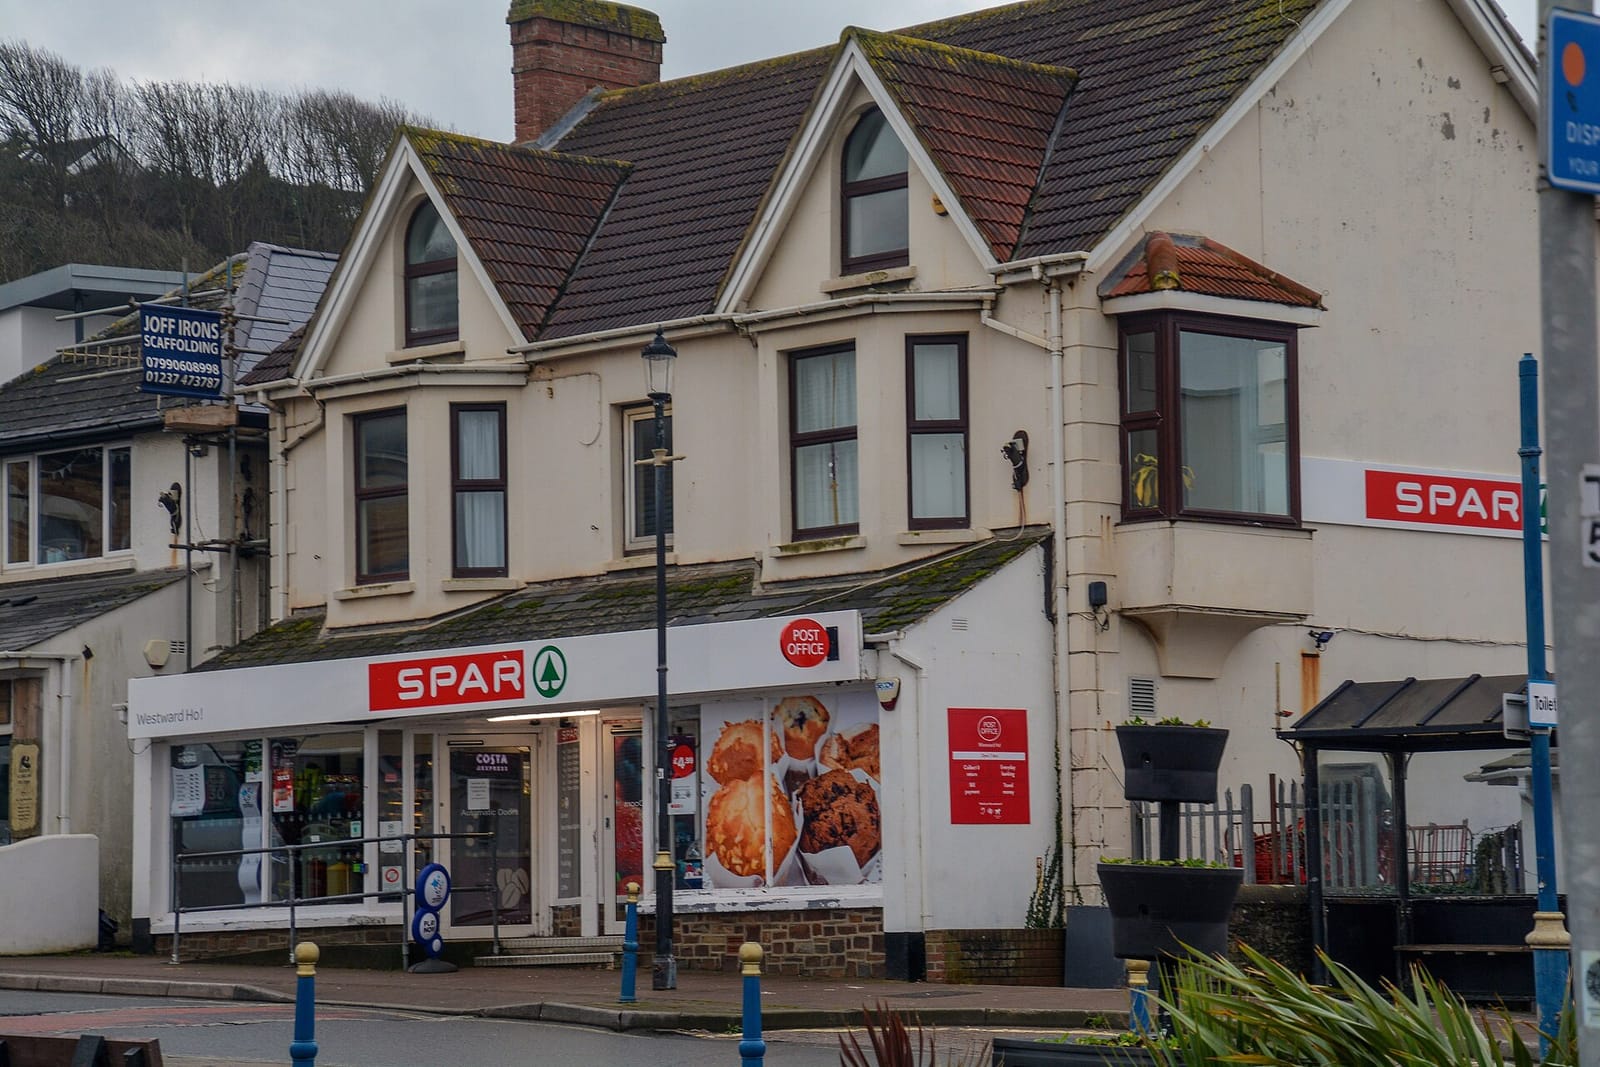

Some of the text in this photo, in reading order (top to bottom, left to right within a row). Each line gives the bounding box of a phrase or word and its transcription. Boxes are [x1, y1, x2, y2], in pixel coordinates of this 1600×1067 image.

[143, 315, 219, 340] JOFF IRONS
[143, 334, 219, 355] SCAFFOLDING
[145, 356, 220, 375] 07990608998
[145, 370, 220, 389] 01237 473787
[1395, 481, 1520, 522] SPAR
[792, 629, 820, 641] POST
[787, 642, 825, 655] OFFICE
[397, 659, 522, 701] SPAR
[136, 707, 204, 726] Westward Ho!
[476, 753, 508, 765] COSTA
